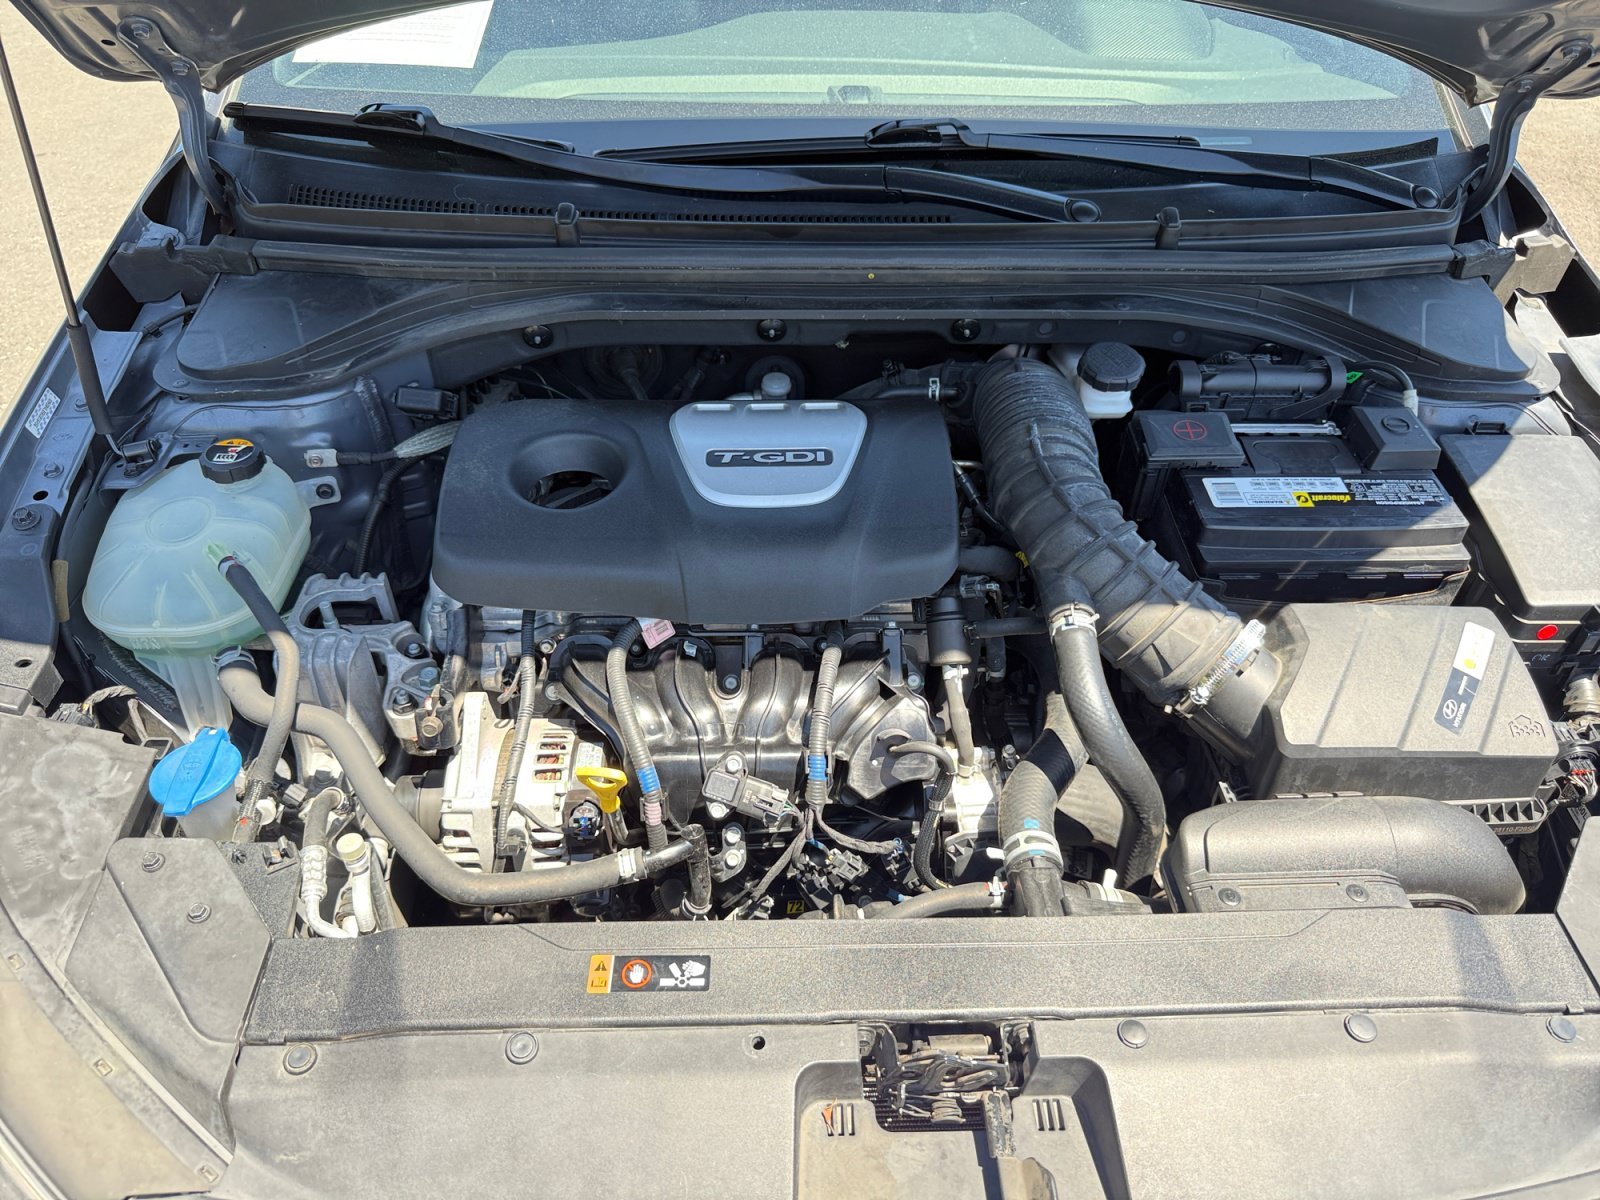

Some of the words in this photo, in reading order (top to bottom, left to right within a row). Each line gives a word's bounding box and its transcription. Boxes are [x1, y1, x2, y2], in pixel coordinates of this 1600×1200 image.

[714, 451, 825, 464] T-GDI
[1312, 494, 1351, 504] Valucraft
[789, 900, 803, 912] 72
